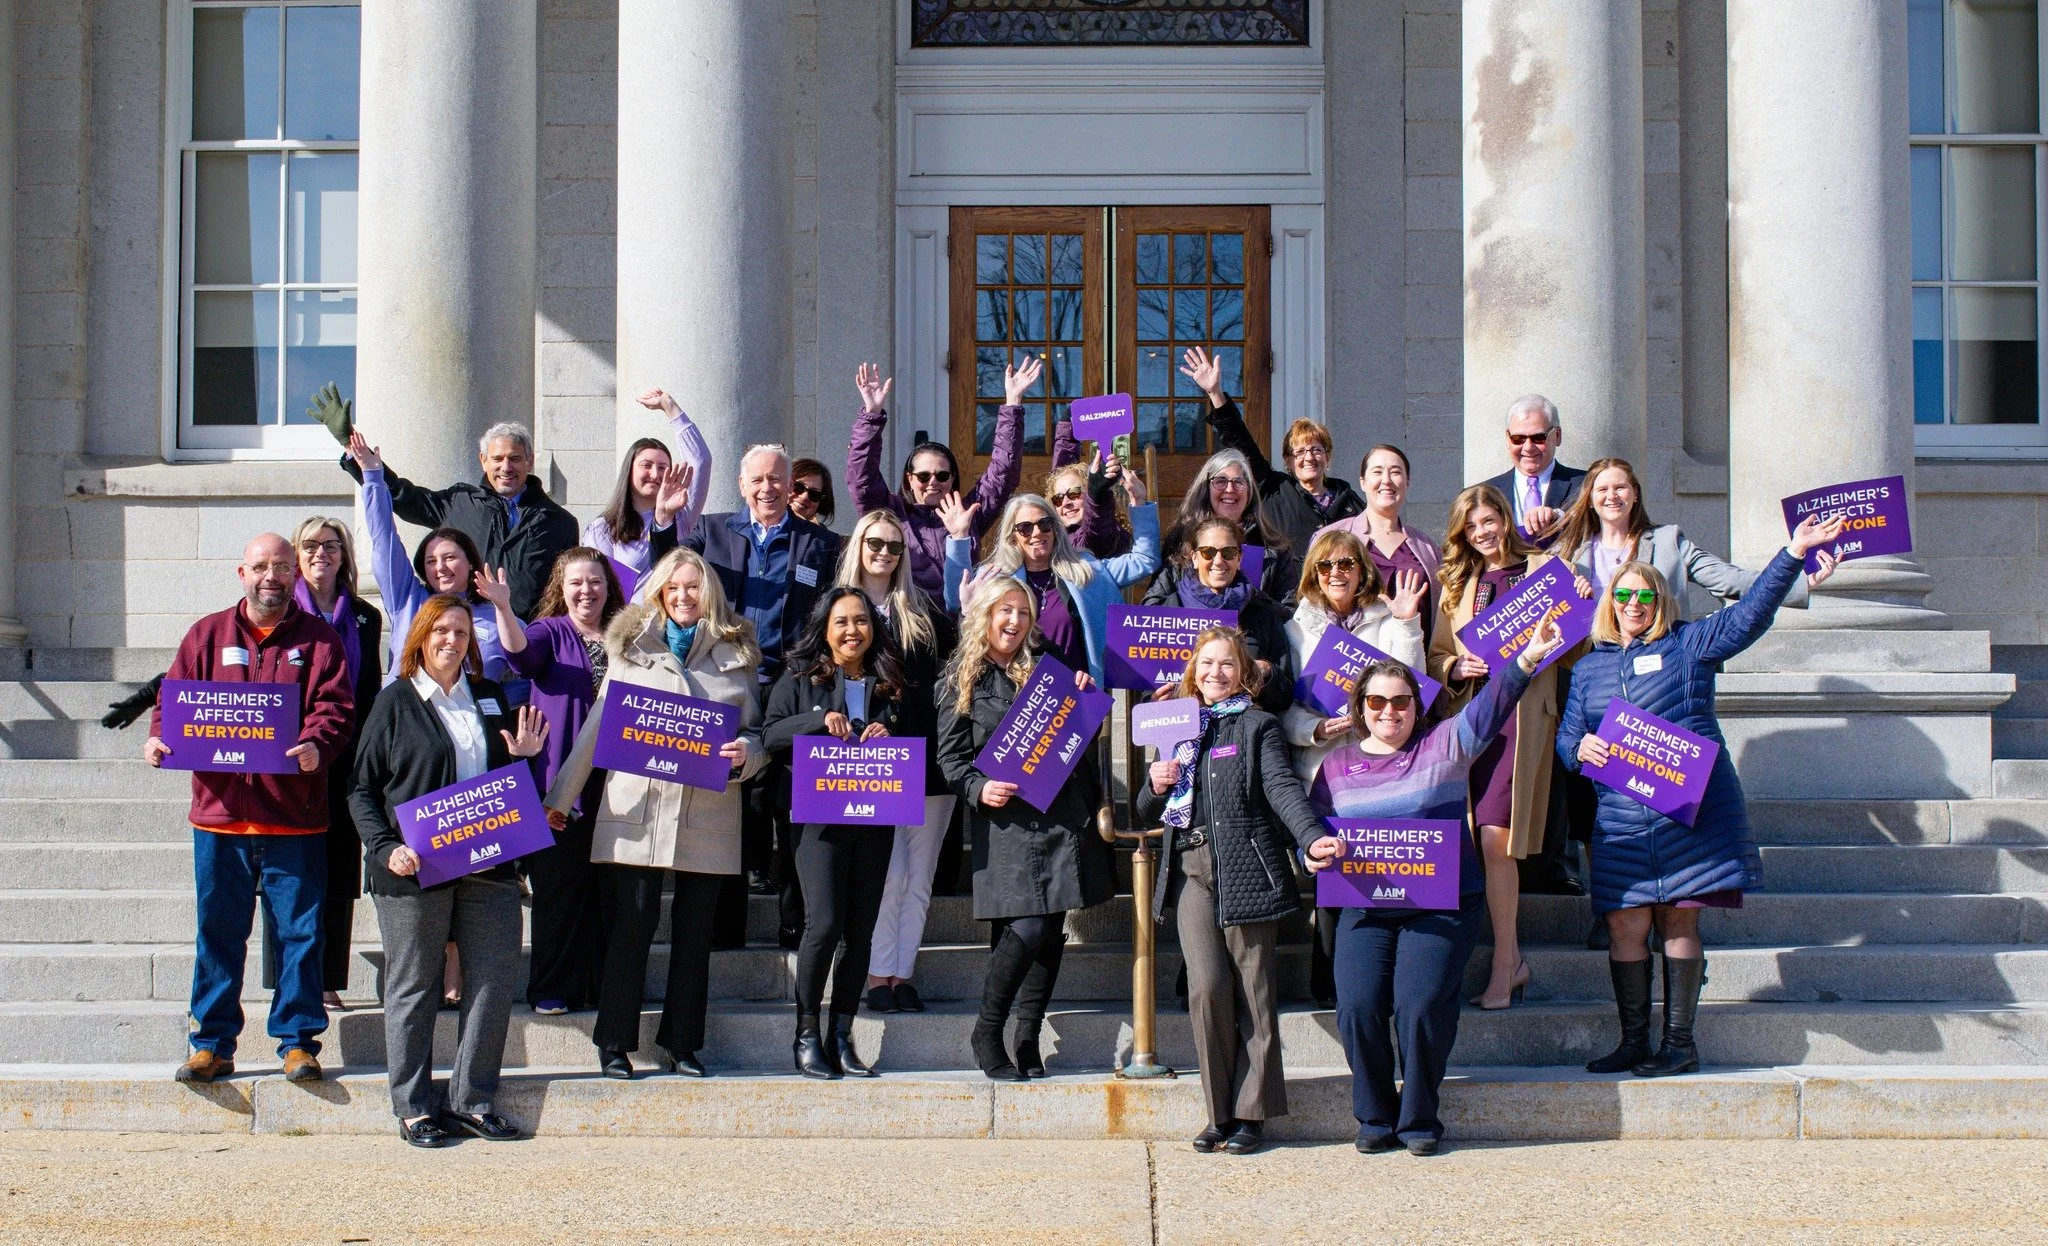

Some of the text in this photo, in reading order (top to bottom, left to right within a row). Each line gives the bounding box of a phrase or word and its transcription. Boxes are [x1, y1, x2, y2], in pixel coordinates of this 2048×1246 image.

[1079, 409, 1126, 421] @ALZIMPACT
[1797, 487, 1889, 515] ALZHEIMER'S
[1842, 515, 1887, 532] YONE
[1843, 541, 1862, 552] AIM
[1476, 573, 1557, 640] ALZHEIMER'S
[1498, 594, 1554, 641] AFFECTS
[1139, 631, 1199, 645] AFFECT
[1128, 646, 1192, 661] EVERYO
[177, 690, 283, 707] ALZHEIMER'S
[193, 708, 264, 723] AFFECTS
[622, 694, 724, 726] ALZHEIMER'S
[993, 672, 1054, 764] ALZHEIMER'S
[636, 713, 705, 738] AFFECTS
[1015, 695, 1059, 758] AFFECTS
[1140, 714, 1190, 729] #ENDALZ
[183, 724, 275, 740] EVERYONE
[1022, 695, 1077, 775] EVERYONE
[1615, 711, 1702, 758] ALZHEIMER'S
[622, 726, 712, 756] EVERYONE
[1064, 732, 1081, 754] AIM
[224, 751, 245, 762] AIM
[809, 746, 910, 760] ALZHEIMER'S
[1622, 732, 1682, 767] AFFECTS
[657, 760, 679, 773] AIM
[826, 763, 893, 776] AFFECTS
[1609, 742, 1686, 786] EVERYONE
[816, 778, 903, 793] EVERYONE
[1635, 781, 1656, 796] AIM
[415, 775, 517, 822] ALZHEIMER'S
[437, 797, 506, 831] AFFECTS
[854, 804, 875, 814] AIM
[430, 808, 522, 850] EVERYONE
[1336, 828, 1443, 843] ALZHEIMER'S
[480, 842, 502, 858] AIM
[1353, 846, 1425, 859] AFFECTS
[1342, 861, 1436, 876] EVERYONE
[1384, 887, 1405, 898] AIM
